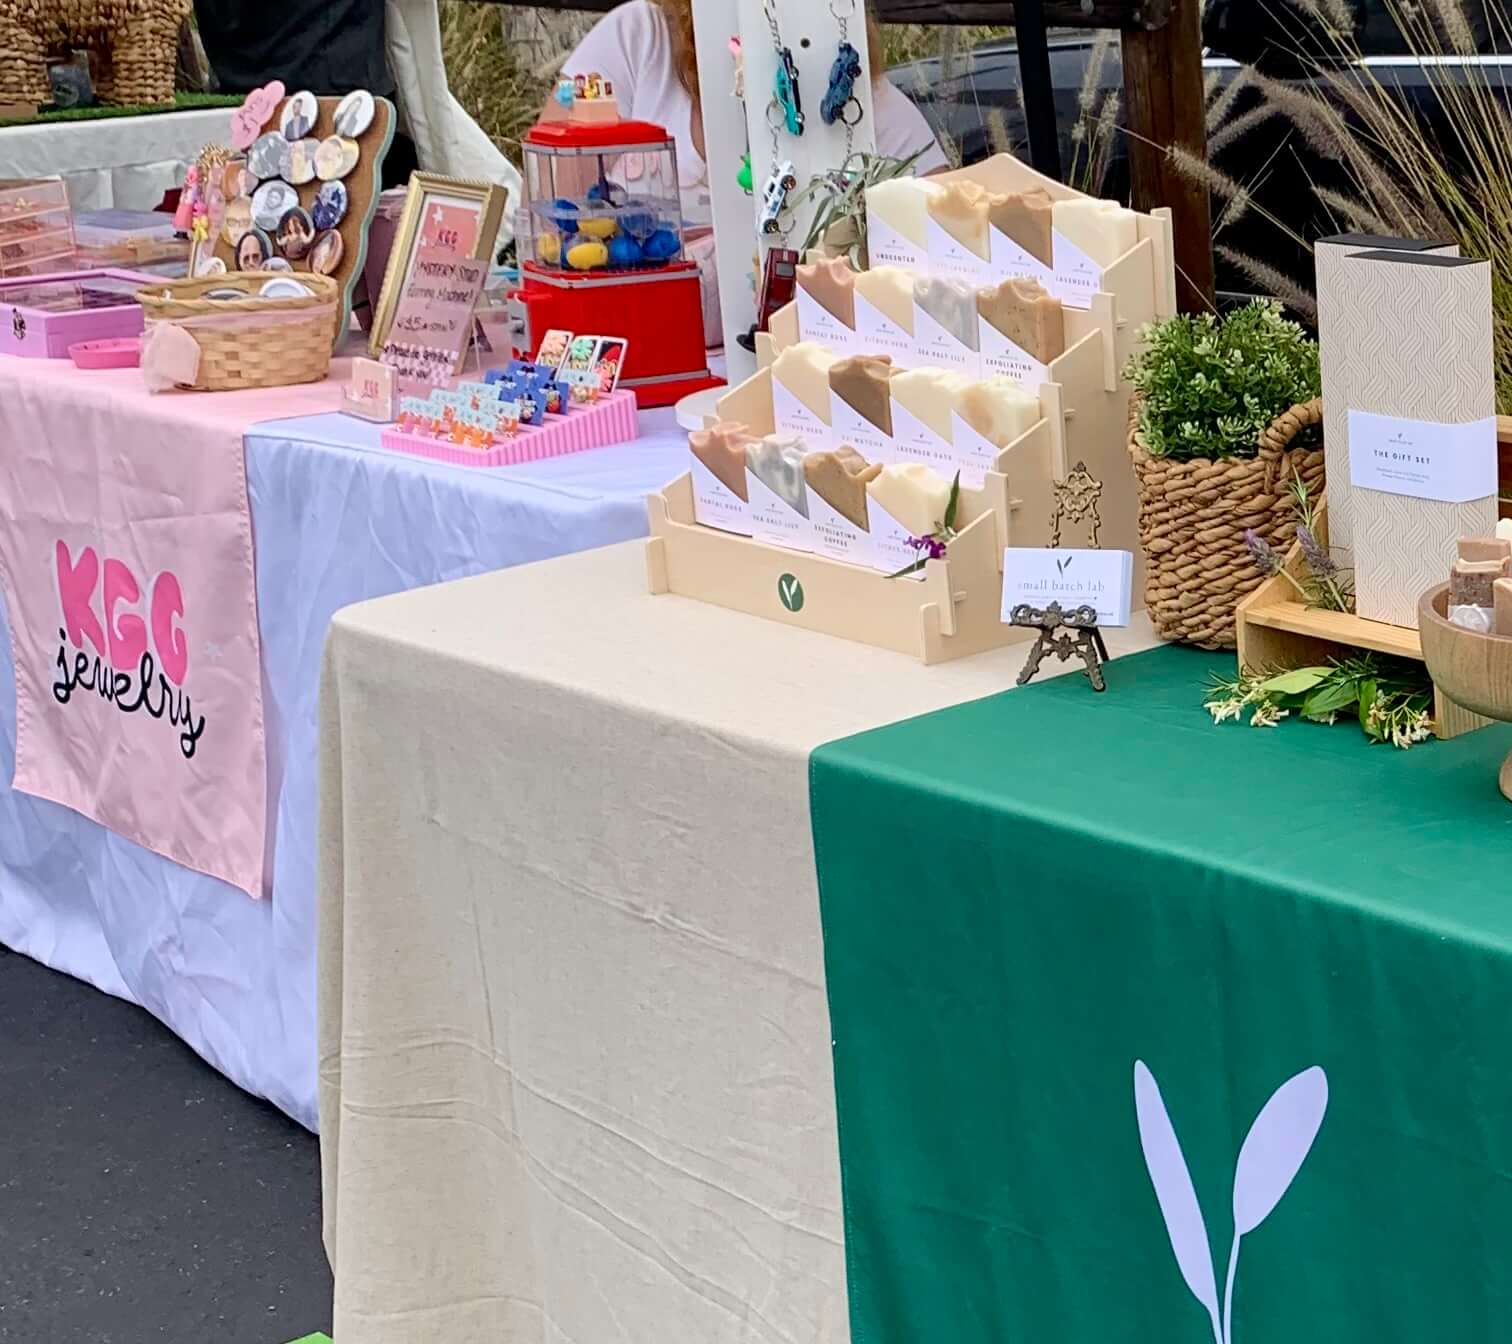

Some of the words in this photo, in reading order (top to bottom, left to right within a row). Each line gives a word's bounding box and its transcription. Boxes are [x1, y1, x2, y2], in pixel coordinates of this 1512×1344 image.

[1374, 449, 1388, 458] THE
[1392, 452, 1411, 462] GIFT
[1416, 456, 1431, 464] SET
[56, 539, 188, 687] KGG
[1018, 579, 1048, 591] small
[1051, 578, 1083, 592] batch
[1087, 580, 1105, 592] lab
[53, 627, 206, 759] jewelry
